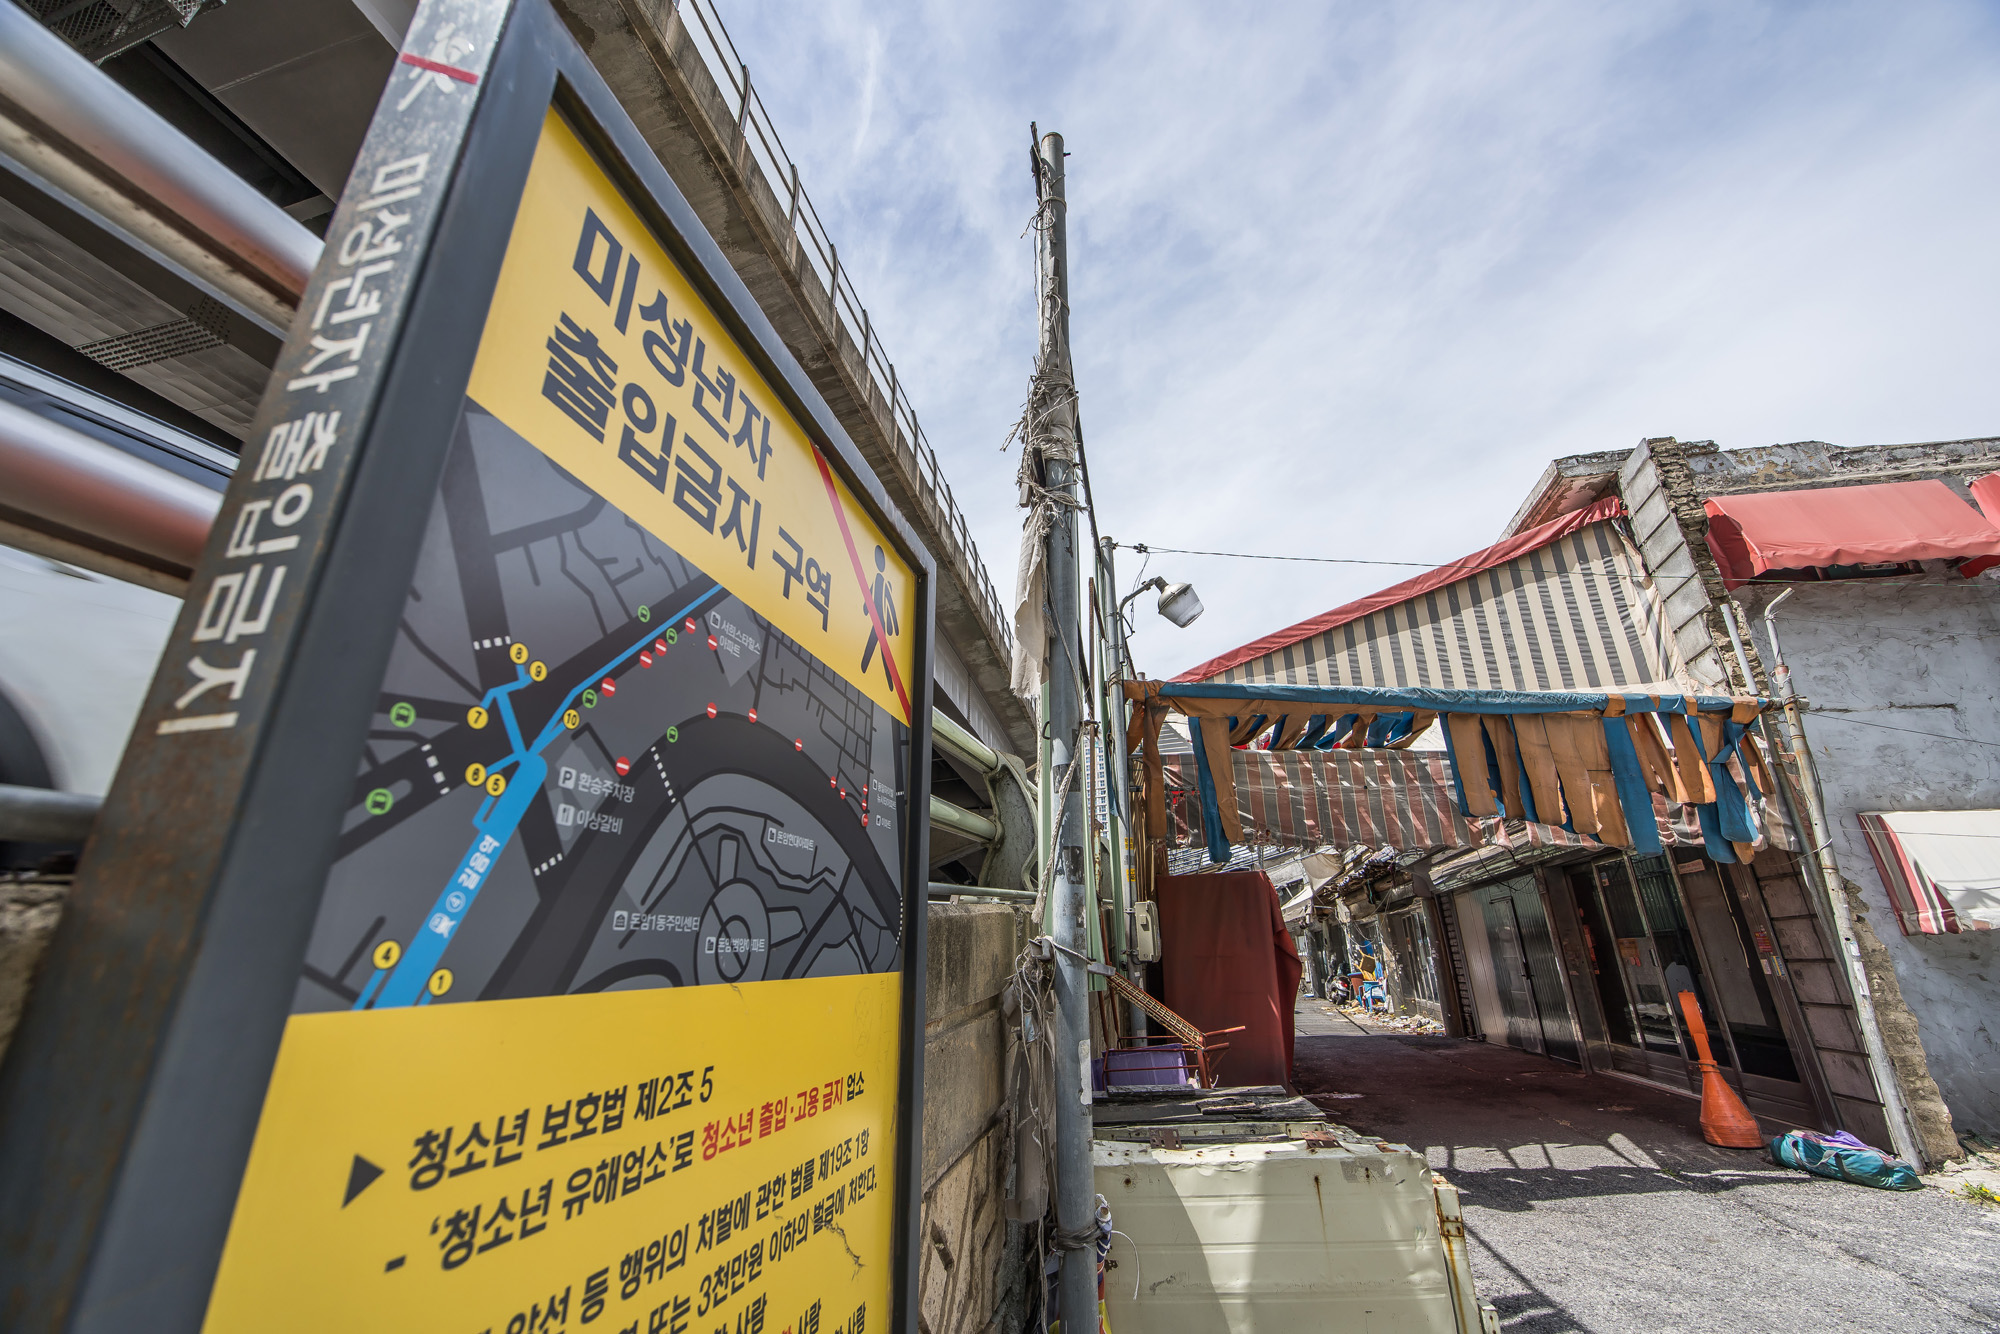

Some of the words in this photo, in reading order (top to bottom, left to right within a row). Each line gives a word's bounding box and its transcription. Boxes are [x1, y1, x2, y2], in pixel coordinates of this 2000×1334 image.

[287, 153, 430, 393] 미성년자
[572, 206, 773, 482] 미성년자
[542, 311, 761, 570] 출입금지
[772, 525, 831, 632] 구역
[156, 411, 341, 735] 출입금지
[720, 635, 741, 657] 아파트
[576, 810, 623, 835] 이상갈비
[578, 772, 635, 803] 환승주차장
[457, 834, 500, 890] 길음역
[630, 913, 700, 932] 돈암1동주민센터
[408, 1108, 530, 1191] 청소년
[537, 1085, 627, 1151] 보호법
[634, 1070, 694, 1121] 제2조
[700, 1066, 714, 1103] 5
[701, 1108, 754, 1161] 청소년
[822, 1077, 844, 1112] 금지
[846, 1071, 865, 1102] 업소
[580, 1266, 609, 1324] 등
[620, 1223, 689, 1301] 행위의
[695, 1191, 751, 1254] 처벌에
[756, 1172, 786, 1221] 관한
[791, 1158, 815, 1200] 법률
[818, 1137, 852, 1182] 제19조
[855, 1127, 869, 1160] 1항
[697, 1238, 764, 1317] 3천만원
[769, 1209, 810, 1262] 이하의
[812, 1184, 846, 1236] 벌금에
